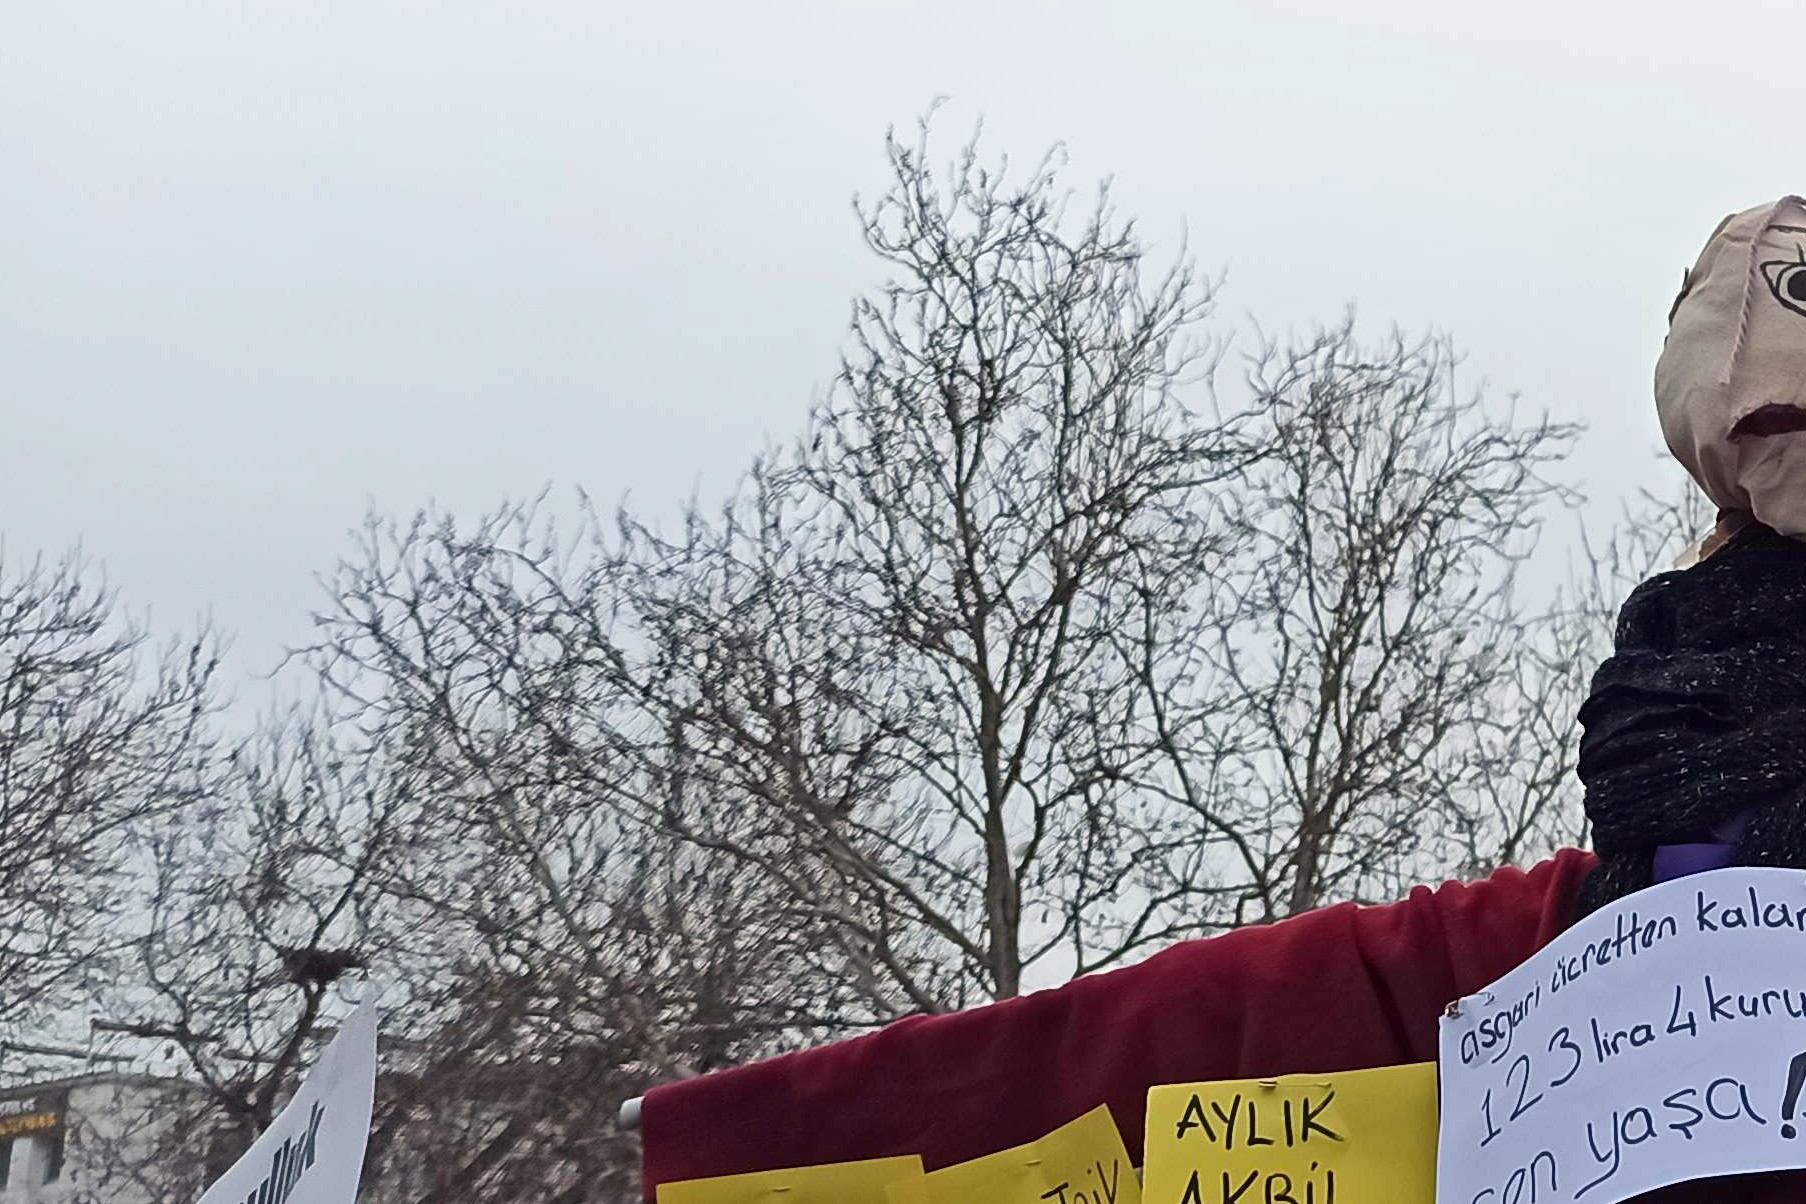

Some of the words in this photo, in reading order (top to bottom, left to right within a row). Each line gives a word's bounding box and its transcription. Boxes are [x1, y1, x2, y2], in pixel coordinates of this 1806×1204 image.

[1461, 980, 1541, 1065] asgari
[1551, 911, 1677, 993] ücretten
[1590, 1017, 1656, 1064] lira
[1665, 984, 1697, 1037] 4
[1175, 1090, 1346, 1151] AYLIK
[1574, 1076, 1767, 1200] yaşa
